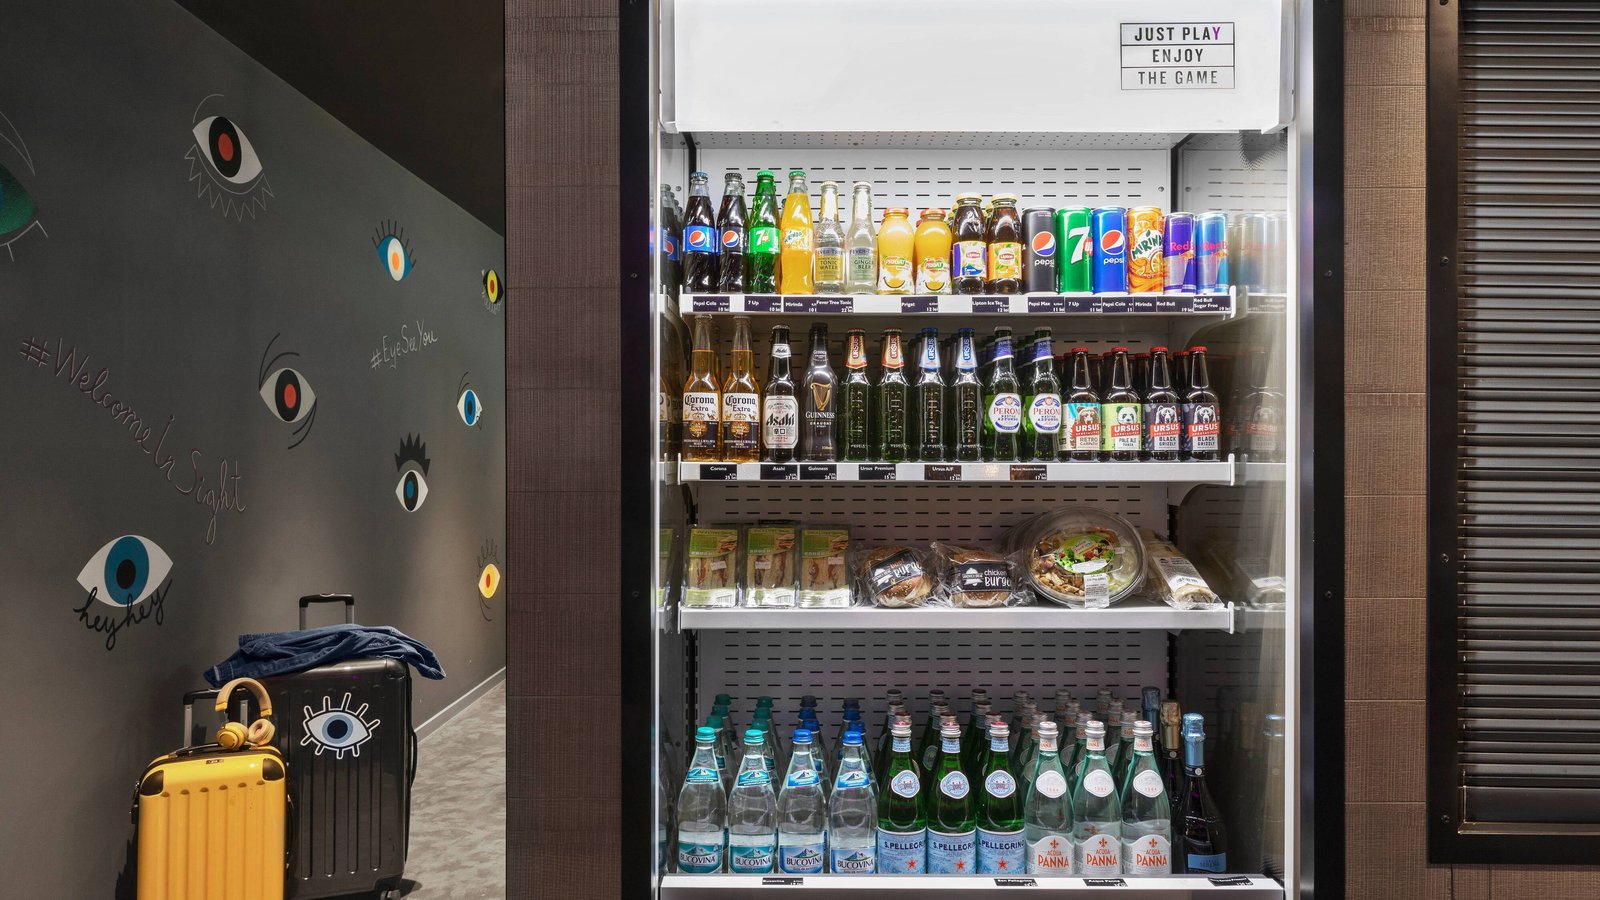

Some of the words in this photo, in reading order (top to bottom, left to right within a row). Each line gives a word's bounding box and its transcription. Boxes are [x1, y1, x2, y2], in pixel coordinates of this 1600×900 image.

[1134, 27, 1175, 41] JUST
[1182, 26, 1221, 41] PLAY
[1152, 48, 1203, 63] ENJOY
[1138, 71, 1167, 84] THE
[1175, 70, 1218, 84] GAME
[684, 394, 715, 406] Corona
[725, 394, 756, 406] Corona
[690, 404, 709, 412] Extra
[732, 404, 751, 412] Extra
[766, 413, 795, 426] Asahi
[1075, 424, 1100, 432] URSUS
[1114, 424, 1140, 432] URSUS
[1153, 424, 1179, 432] URSUS
[1191, 423, 1218, 432] URSUS
[884, 841, 926, 850] S.PELLEGR
[933, 842, 976, 851] S.PELLEGR
[680, 853, 716, 864] BUCOVINA
[735, 856, 771, 866] BUCOVINA
[786, 856, 822, 866] BUCOVINA
[837, 858, 874, 869] BUCOVINA
[1037, 855, 1069, 868] PANNA
[1086, 854, 1118, 867] PANNA
[1136, 854, 1168, 867] PANNA
